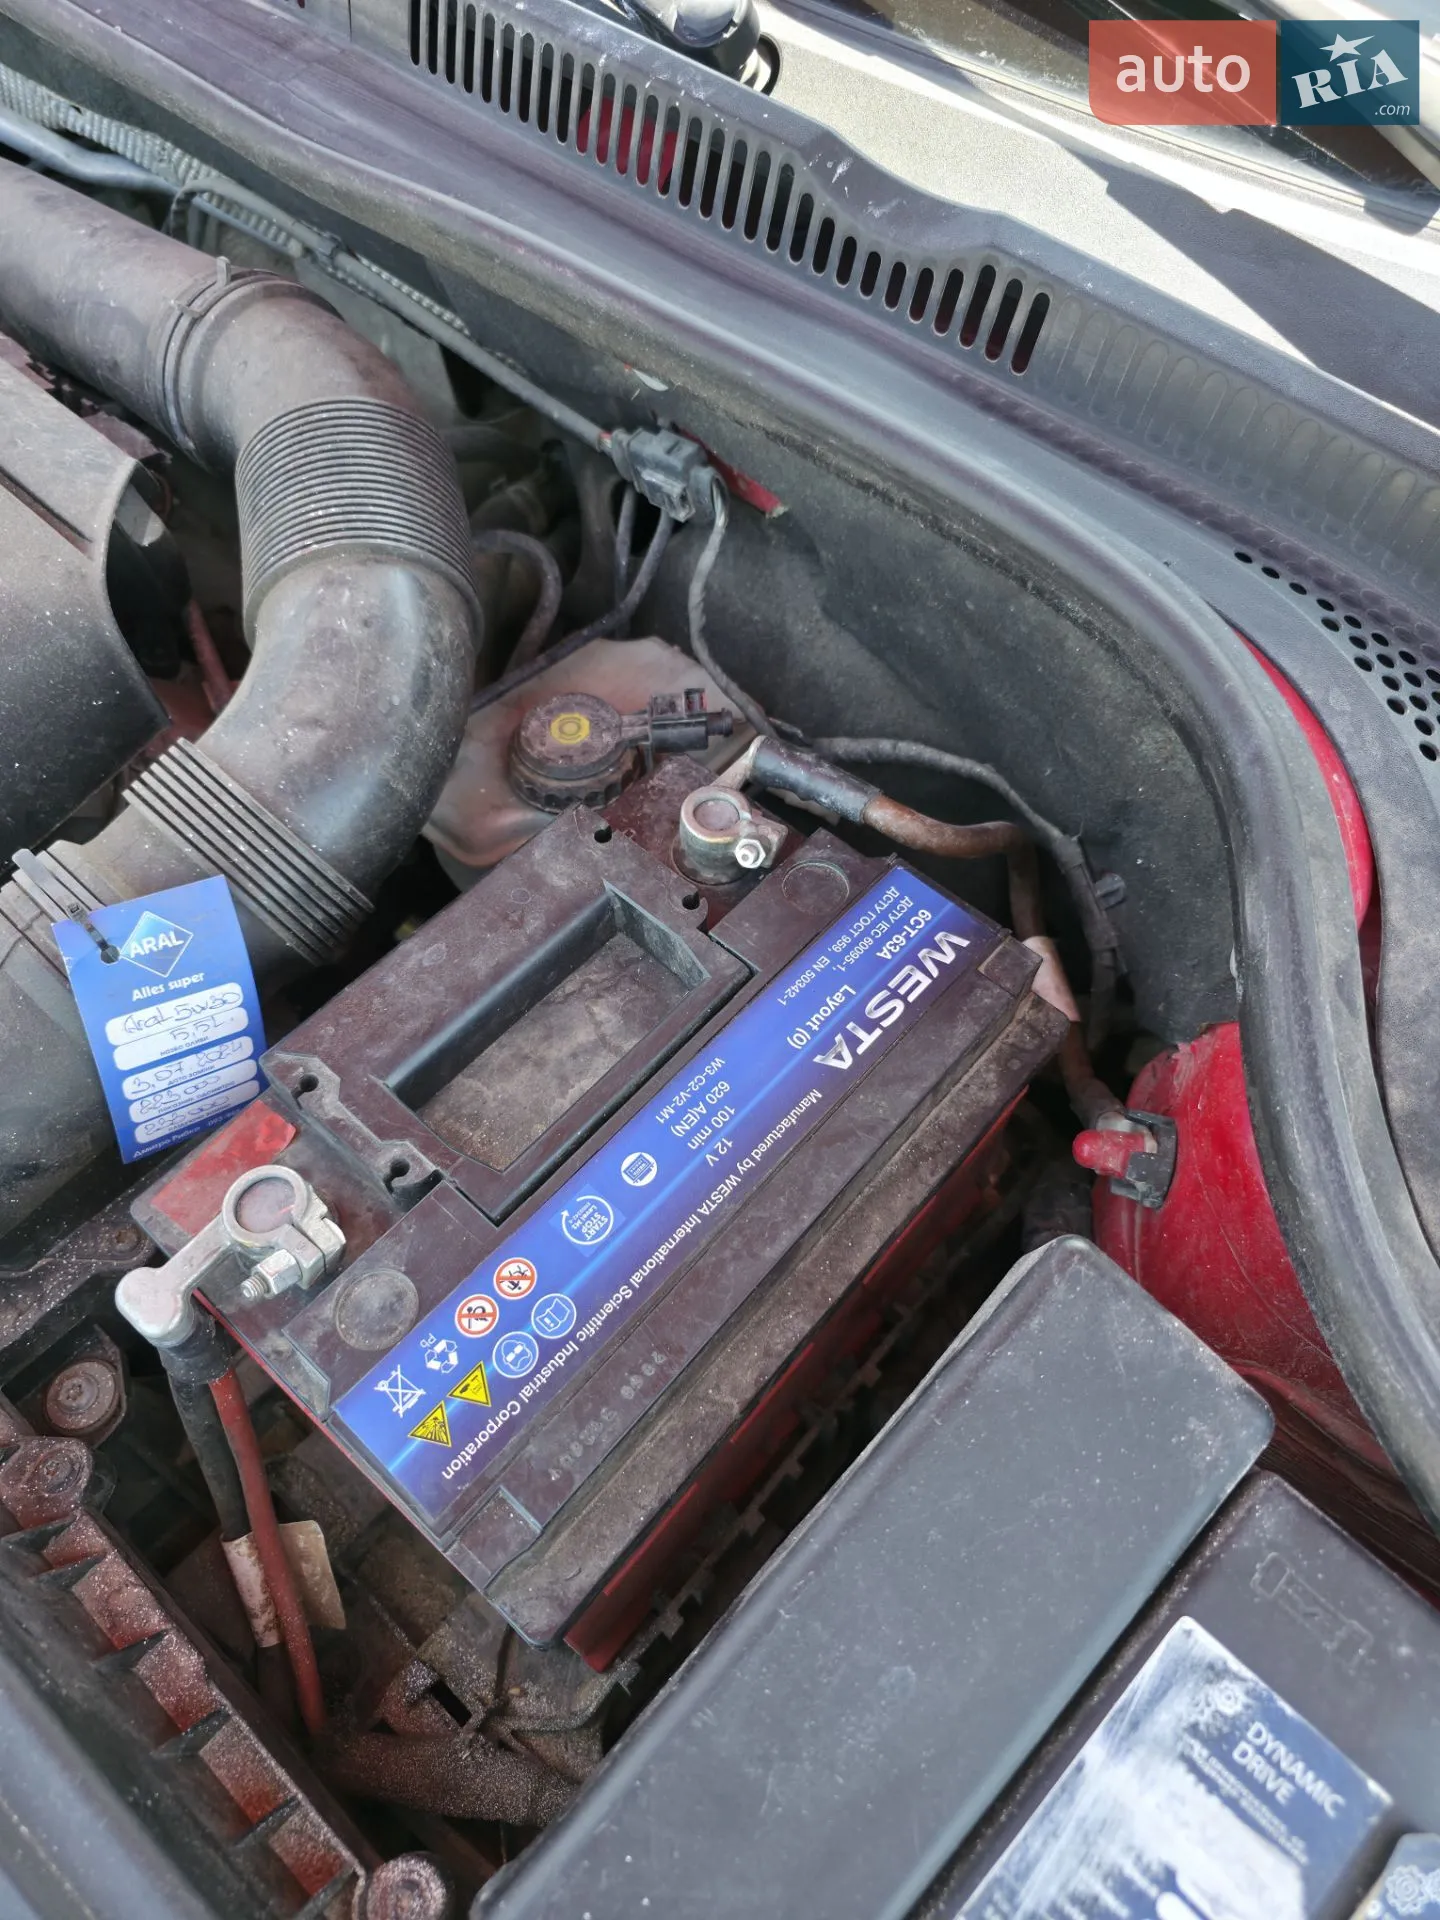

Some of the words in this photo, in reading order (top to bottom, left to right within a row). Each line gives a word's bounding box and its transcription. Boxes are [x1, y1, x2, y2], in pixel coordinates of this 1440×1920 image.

[874, 886, 900, 912] ДСТУ
[889, 896, 914, 924] ДСТУ
[853, 910, 877, 937] ГОСТ
[874, 921, 890, 939] IEC
[130, 931, 184, 958] ARAL
[828, 935, 851, 954] 959,
[832, 936, 874, 972] 60095-1,
[813, 956, 831, 972] EN
[132, 984, 165, 1002] Alles
[168, 972, 205, 990] super
[777, 969, 816, 1006] 50342-1
[813, 931, 971, 1070] WESTA
[806, 984, 856, 1031] Layout
[786, 1028, 812, 1050] (0)
[655, 1057, 726, 1124] W3-C2-V2-M1
[705, 1081, 731, 1104] 620
[670, 1102, 707, 1137] A(EN)
[711, 1105, 736, 1128] 100
[751, 1088, 823, 1163] Manufactured
[687, 1125, 712, 1150] min
[714, 1137, 733, 1155] 12
[705, 1153, 719, 1167] V
[736, 1157, 755, 1175] by
[697, 1174, 741, 1216] WESTA
[582, 1212, 601, 1233] STOP
[585, 1215, 608, 1240] START
[629, 1214, 702, 1288] International
[576, 1285, 633, 1342] Scientific
[420, 1333, 437, 1348] Pb
[518, 1341, 580, 1403] Industrial
[441, 1400, 521, 1480] Corporation
[1232, 1741, 1296, 1806] DRIVE
[1247, 1721, 1346, 1819] DYNAMIC
